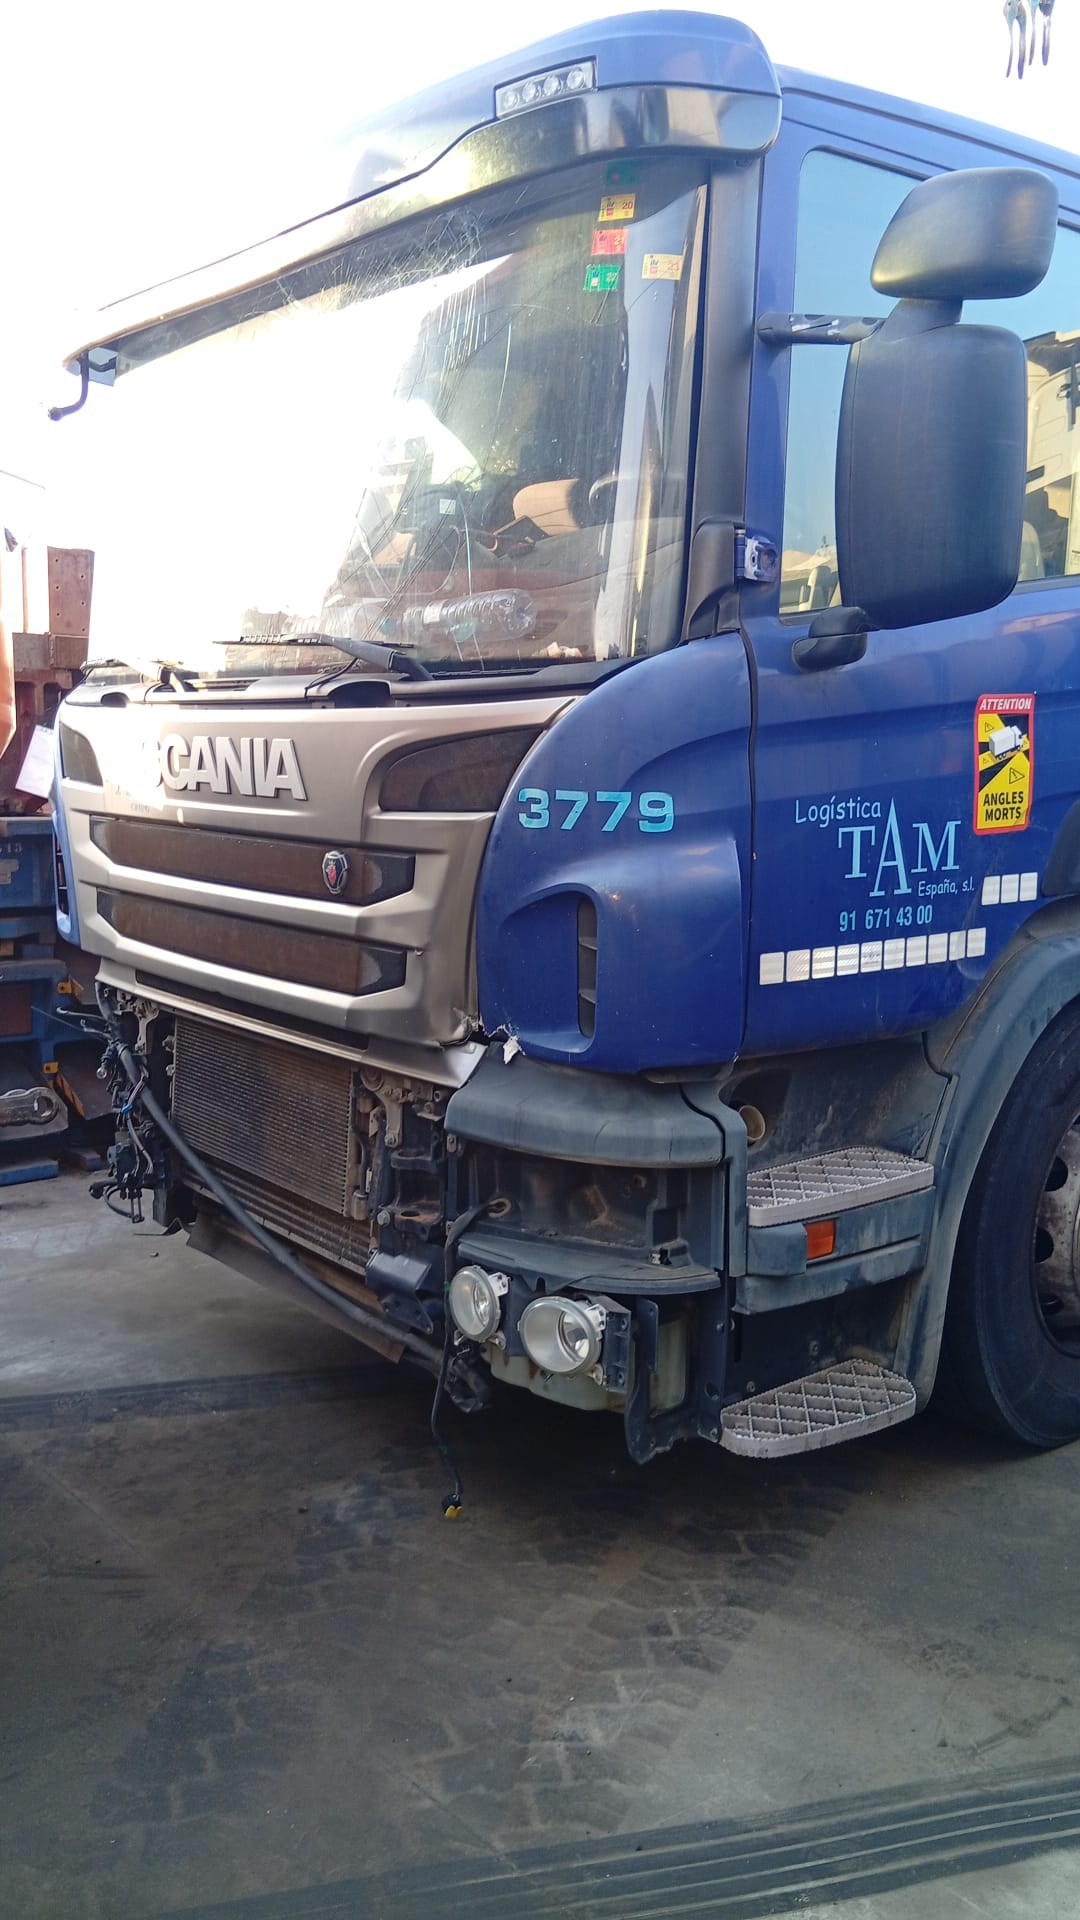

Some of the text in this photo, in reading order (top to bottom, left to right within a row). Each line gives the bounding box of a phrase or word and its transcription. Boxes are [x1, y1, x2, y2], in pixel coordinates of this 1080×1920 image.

[622, 201, 634, 210] 20
[979, 698, 1032, 711] ATTENTION
[518, 788, 674, 833] 3779
[983, 791, 1024, 806] ANGLES
[795, 796, 881, 828] Logística
[984, 807, 1022, 822] MORTS
[838, 797, 961, 897] TAM
[918, 876, 975, 900] España, s.l.
[839, 904, 933, 932] 91 671 43 00
